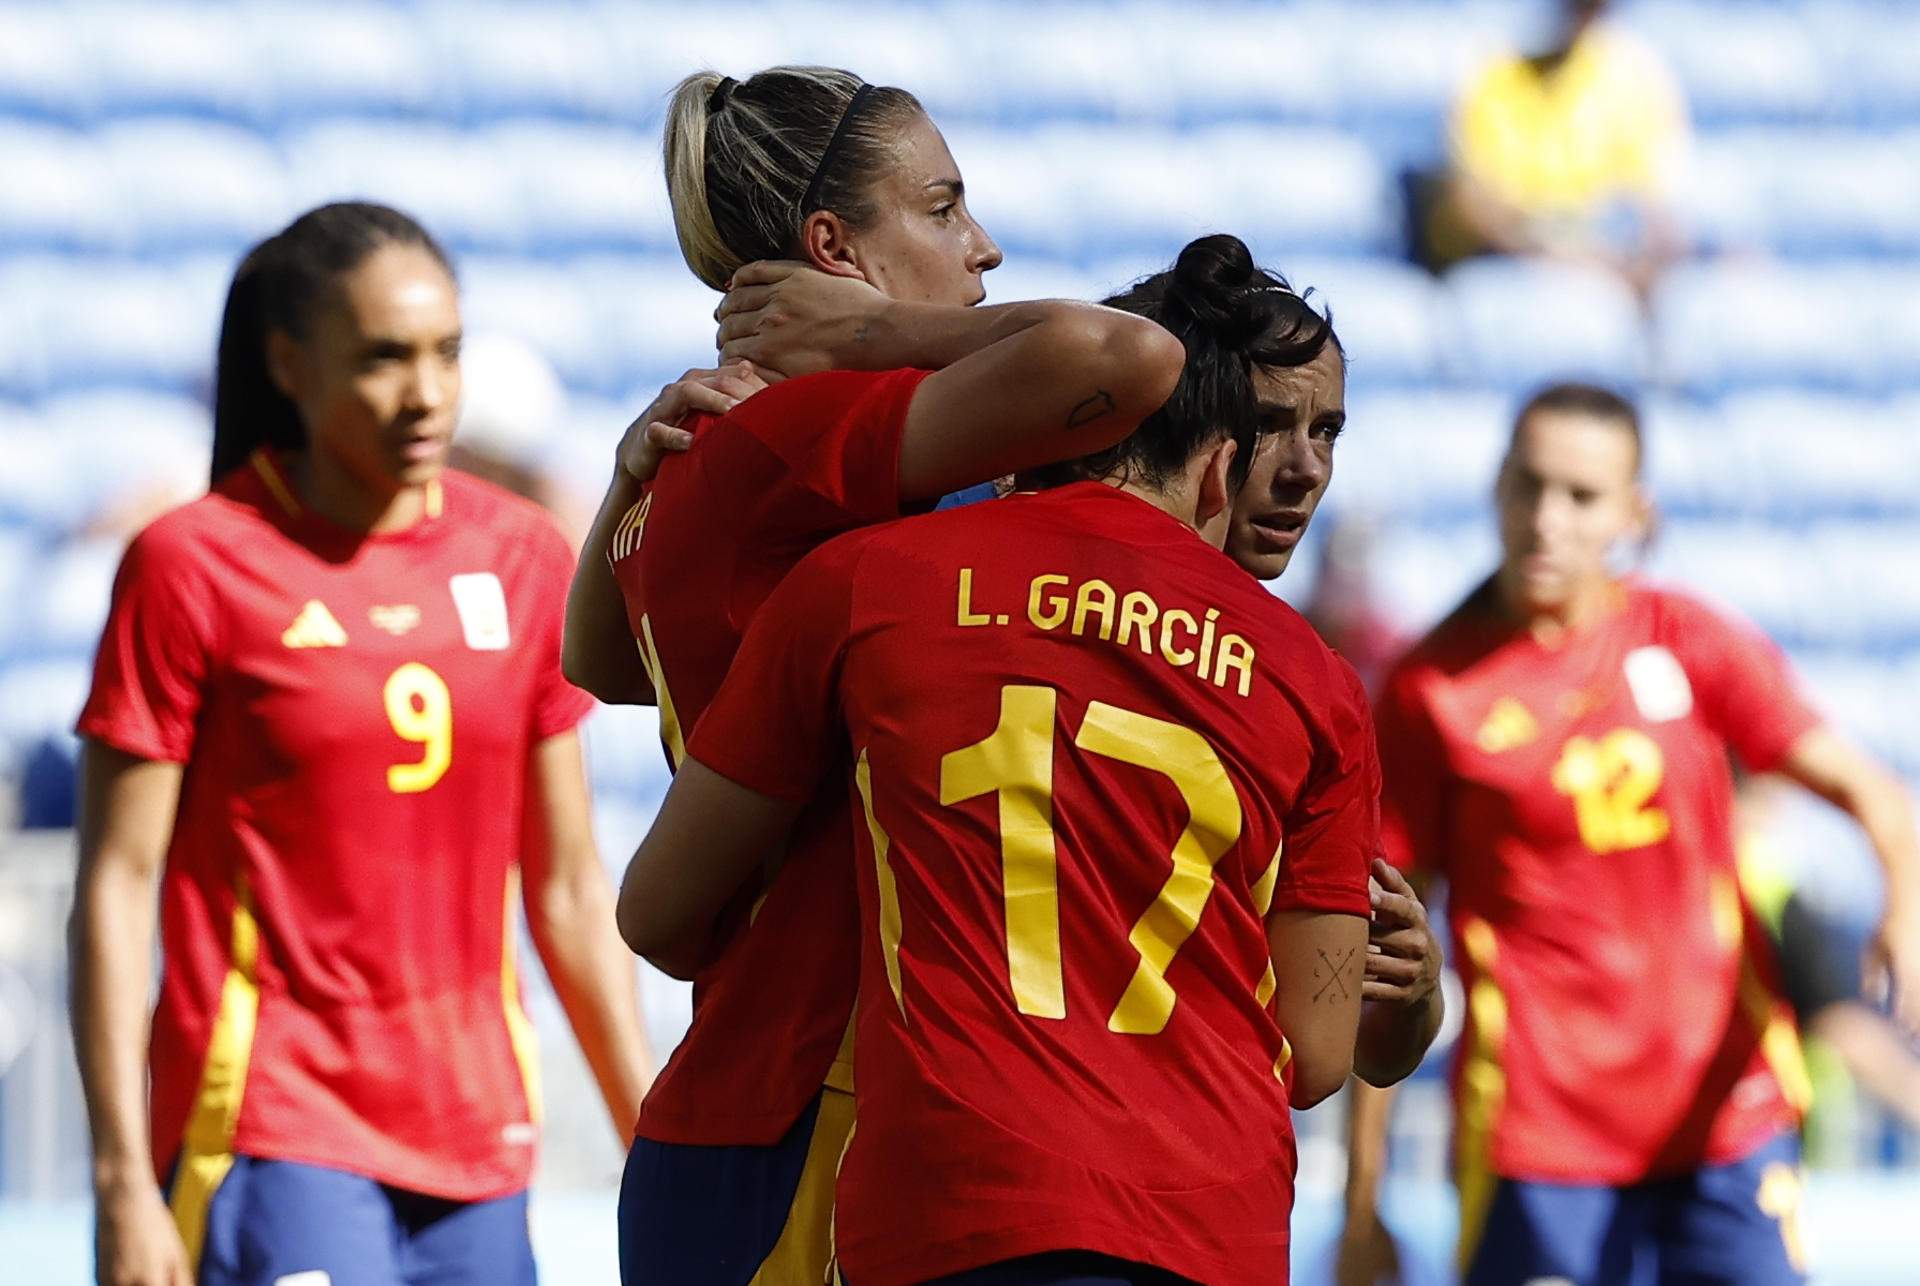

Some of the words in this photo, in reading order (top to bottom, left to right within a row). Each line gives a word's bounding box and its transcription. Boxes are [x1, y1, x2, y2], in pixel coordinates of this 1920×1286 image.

[957, 568, 1009, 626] L.
[1027, 574, 1255, 697] GARCÍA
[383, 662, 452, 793] 9
[1553, 727, 1670, 855] 12
[940, 685, 1242, 1034] 17
